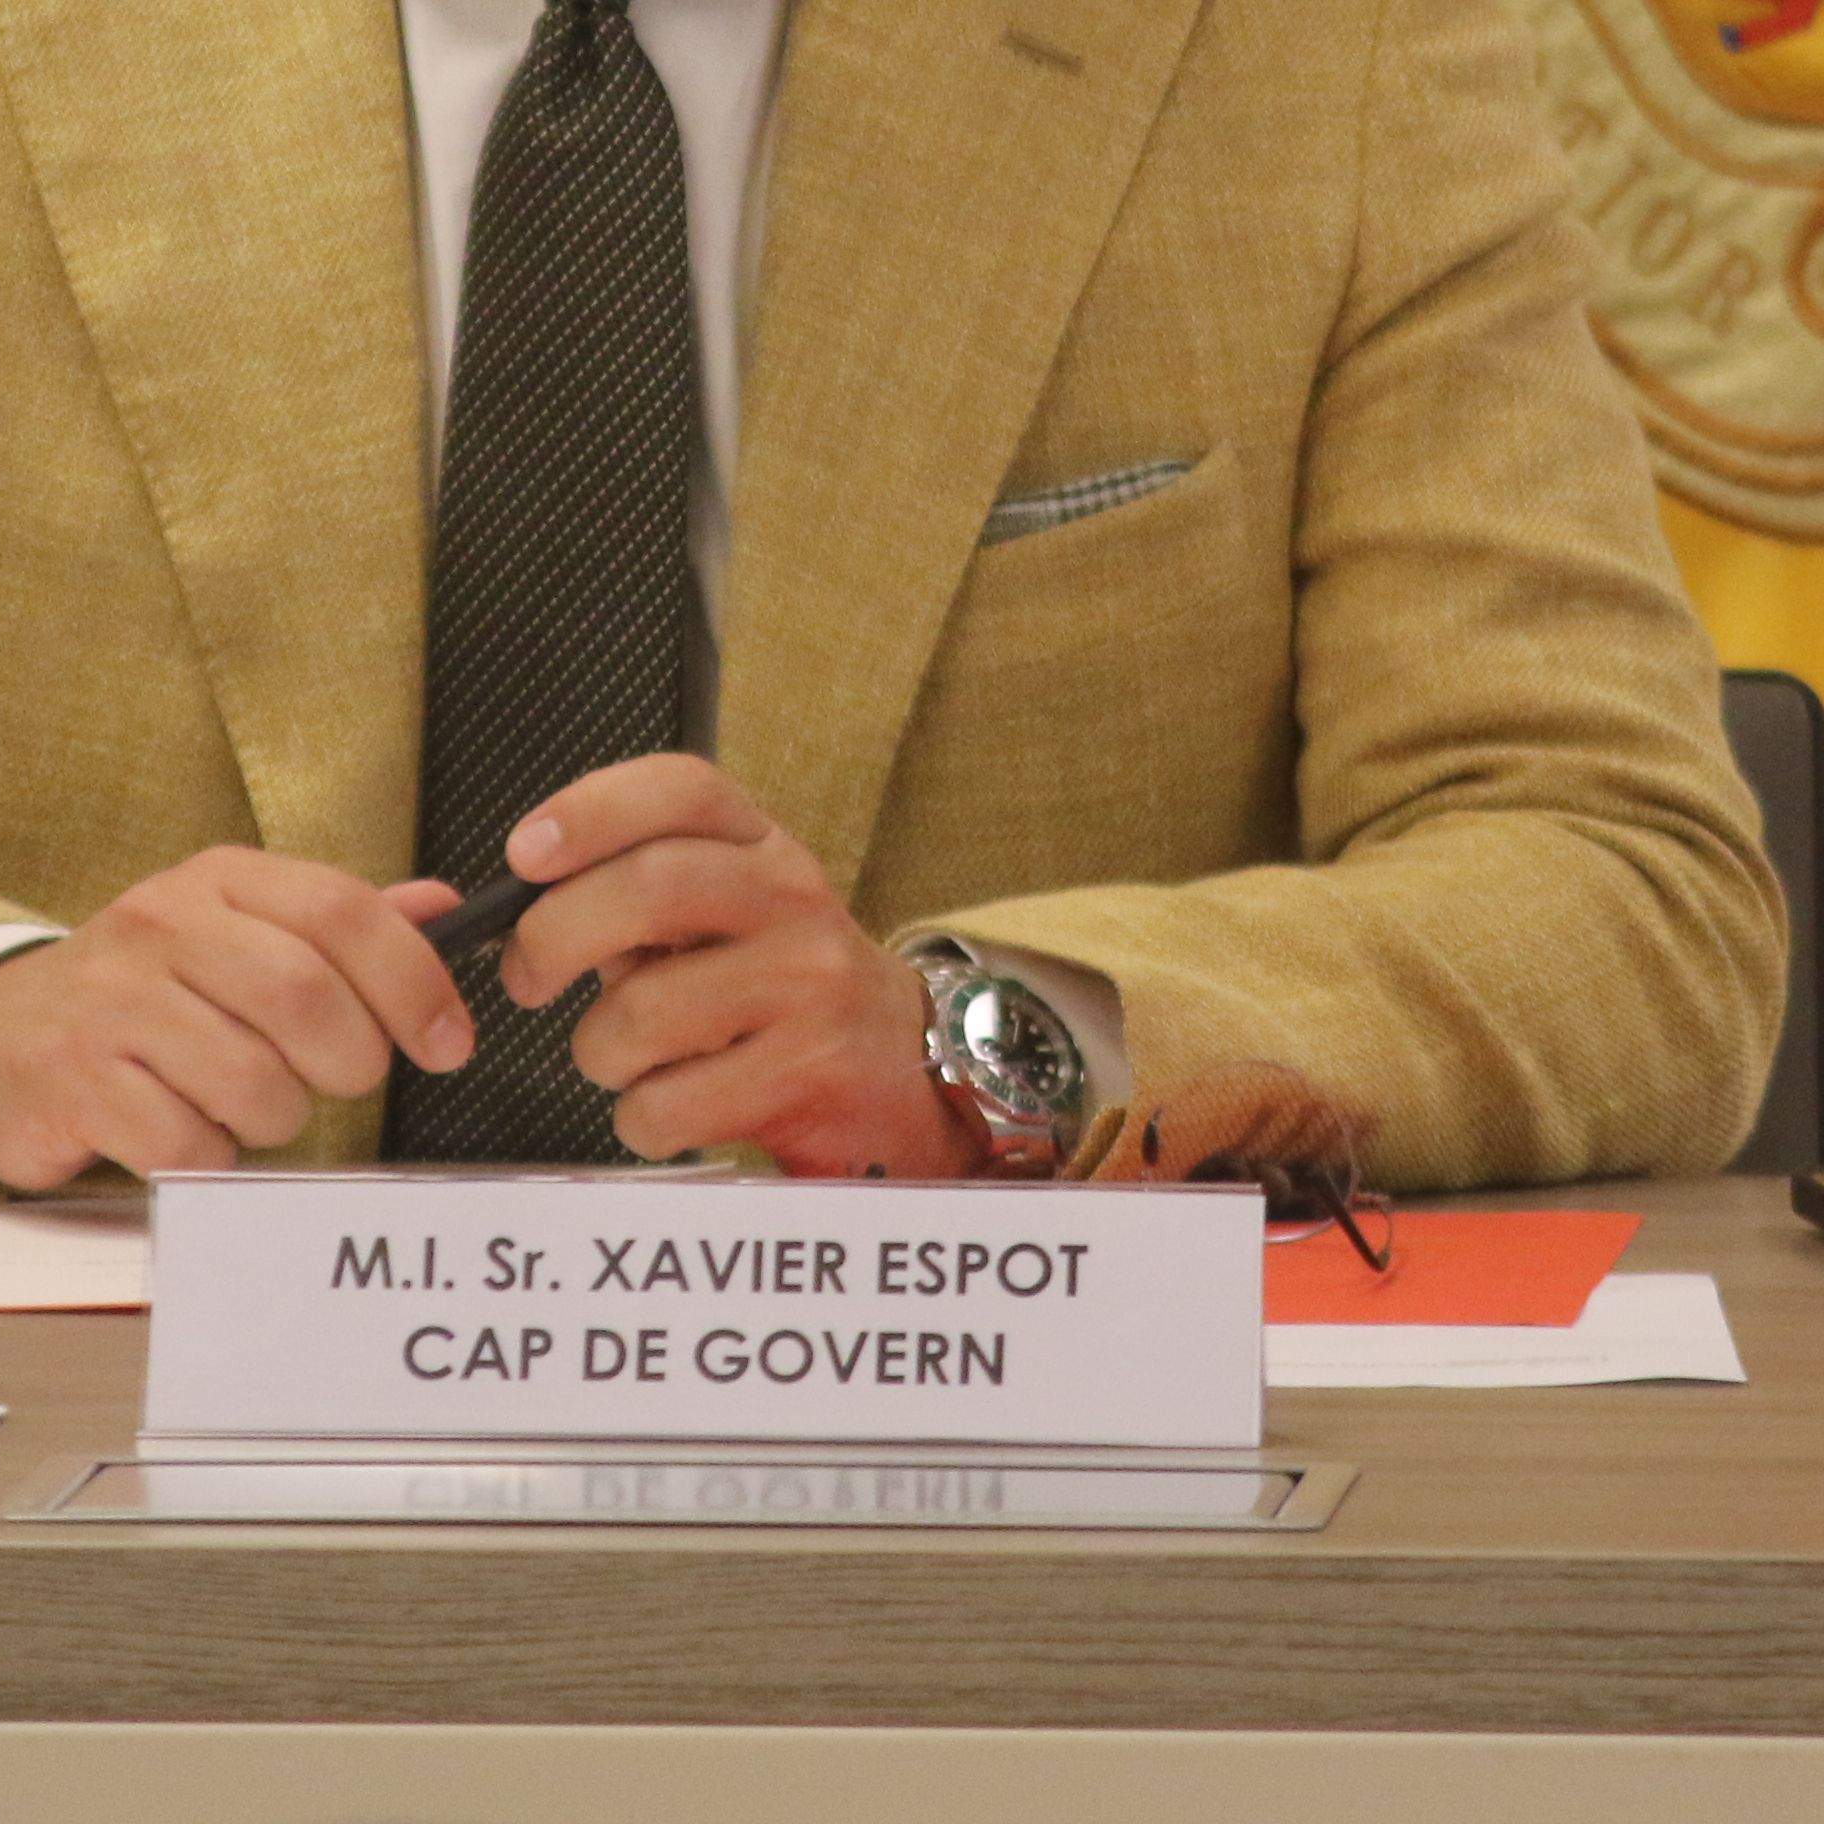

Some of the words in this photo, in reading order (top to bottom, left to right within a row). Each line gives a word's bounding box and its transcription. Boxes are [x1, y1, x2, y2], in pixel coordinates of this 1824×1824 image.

[329, 1233, 457, 1292] M.I.
[481, 1234, 563, 1293] Sr.
[588, 1236, 849, 1295] XAVIER
[875, 1239, 1091, 1299] ESPOT
[401, 1323, 555, 1383] CAP
[580, 1325, 669, 1384] DE
[692, 1326, 1007, 1387] GOVERN
